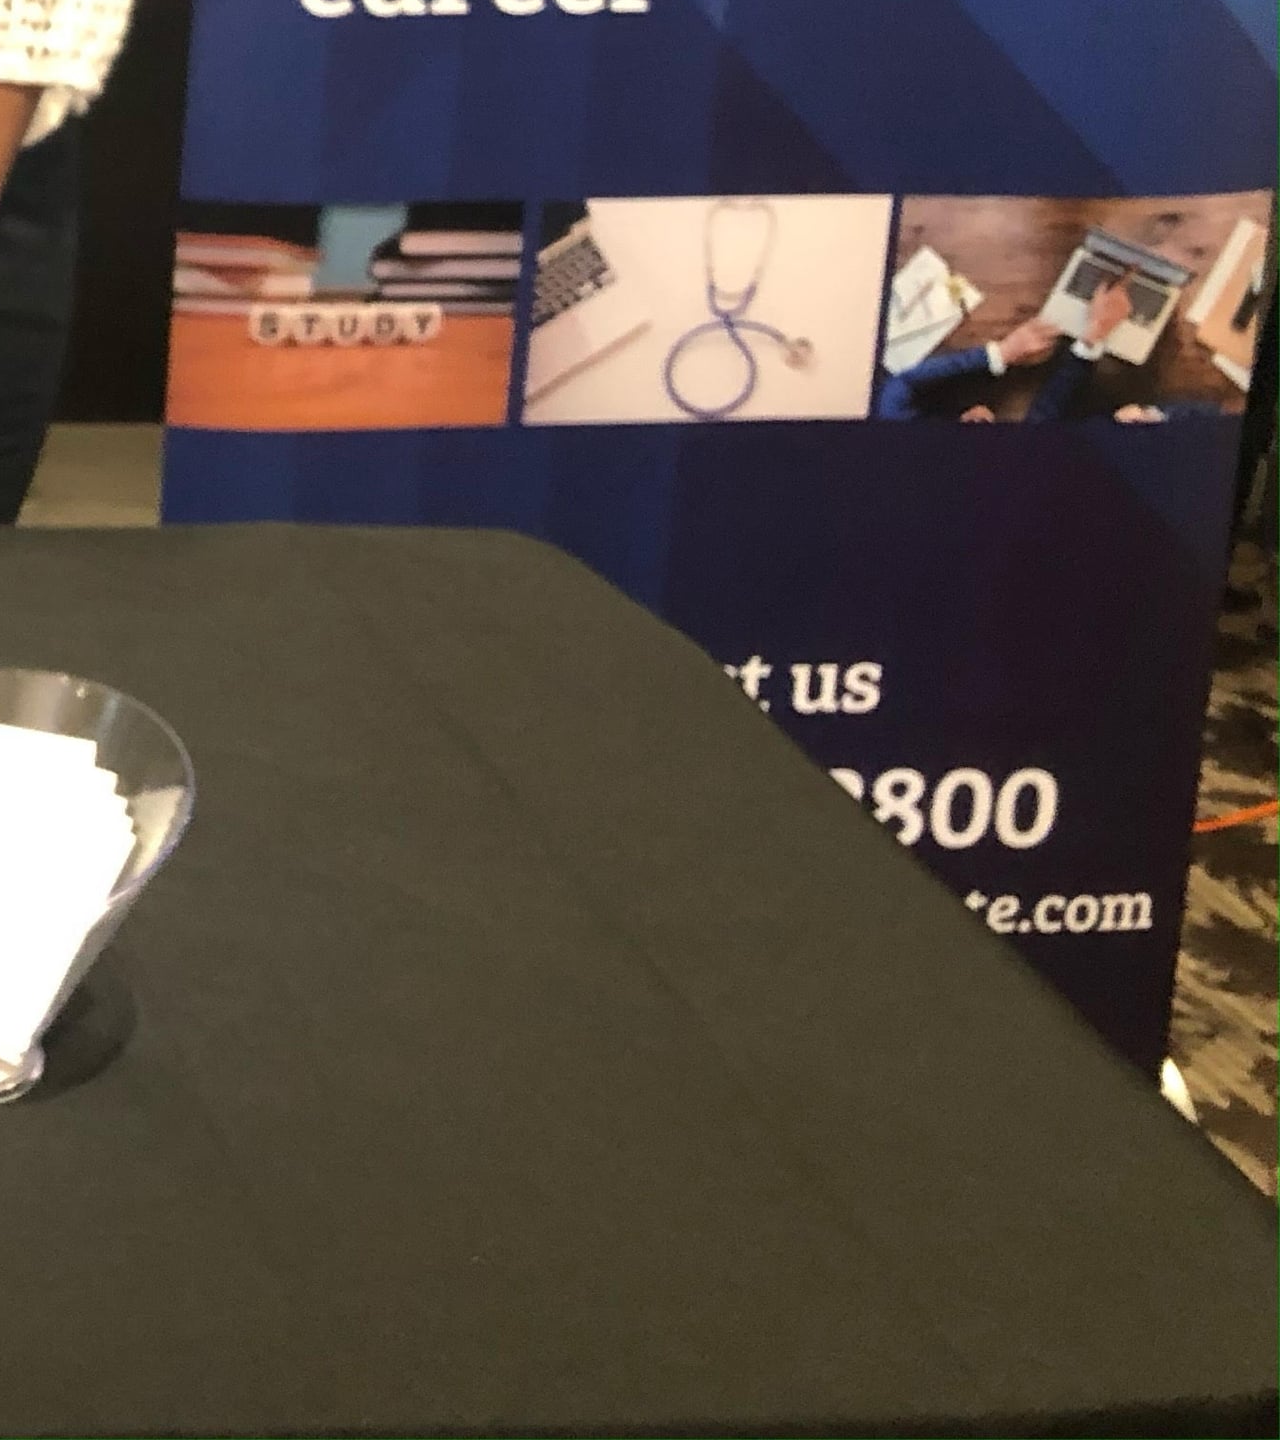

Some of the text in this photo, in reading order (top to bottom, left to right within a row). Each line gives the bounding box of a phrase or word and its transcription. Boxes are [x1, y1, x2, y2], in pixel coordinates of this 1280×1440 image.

[258, 311, 433, 339] STUDY
[790, 661, 883, 714] us
[829, 767, 1059, 850] 800
